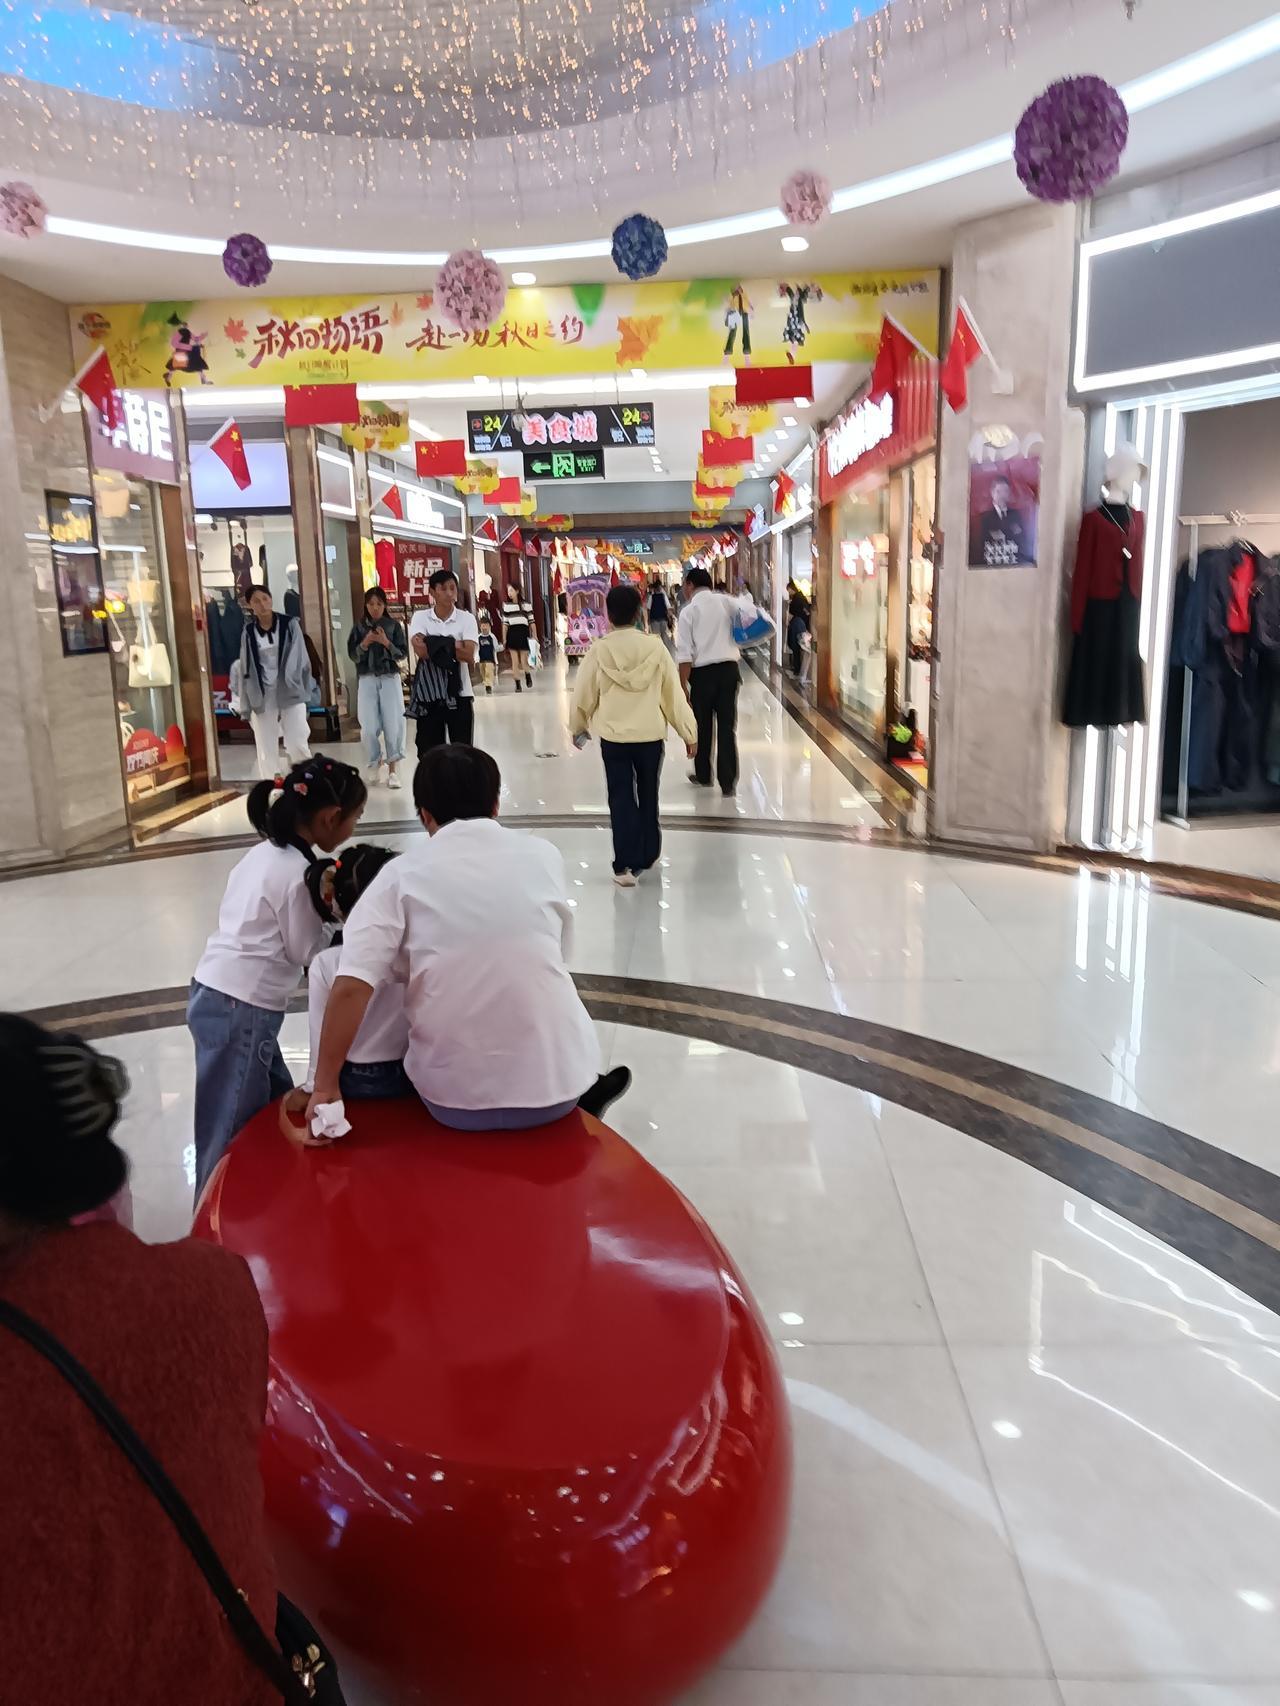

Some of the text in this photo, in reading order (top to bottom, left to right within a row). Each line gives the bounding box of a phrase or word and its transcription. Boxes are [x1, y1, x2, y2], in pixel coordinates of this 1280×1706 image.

[483, 415, 501, 432] 24
[622, 407, 641, 426] 24
[522, 410, 598, 445] 美食城
[403, 558, 443, 578] 新品
